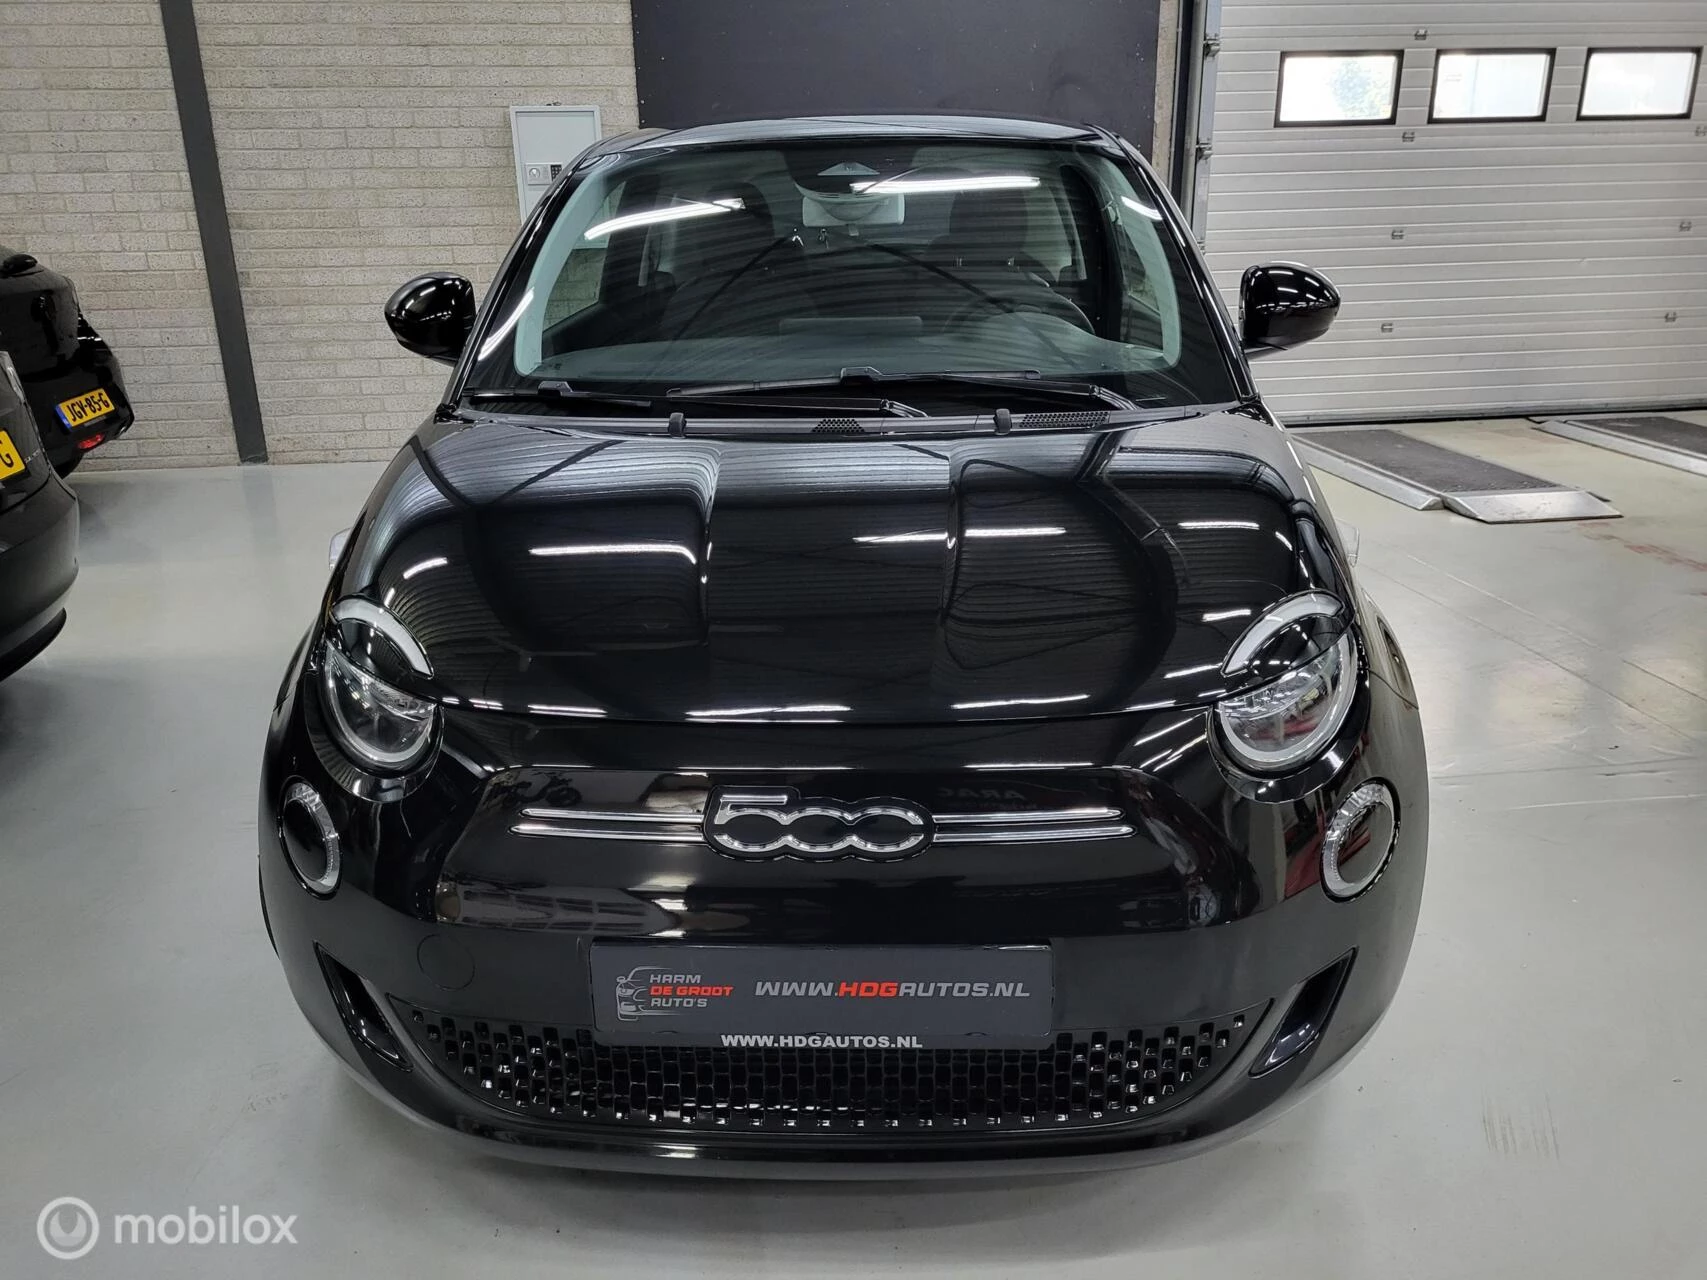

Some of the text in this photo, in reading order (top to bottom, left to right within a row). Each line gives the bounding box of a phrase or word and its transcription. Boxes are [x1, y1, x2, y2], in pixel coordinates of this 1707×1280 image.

[714, 795, 924, 852] 500
[650, 975, 701, 984] HARM
[650, 986, 733, 997] DE GROOT
[755, 981, 1030, 997] WWW.HDGAUTOS.NL
[651, 998, 708, 1008] AUTO'S
[721, 1034, 922, 1049] WWW.HDGAUTOS.NL
